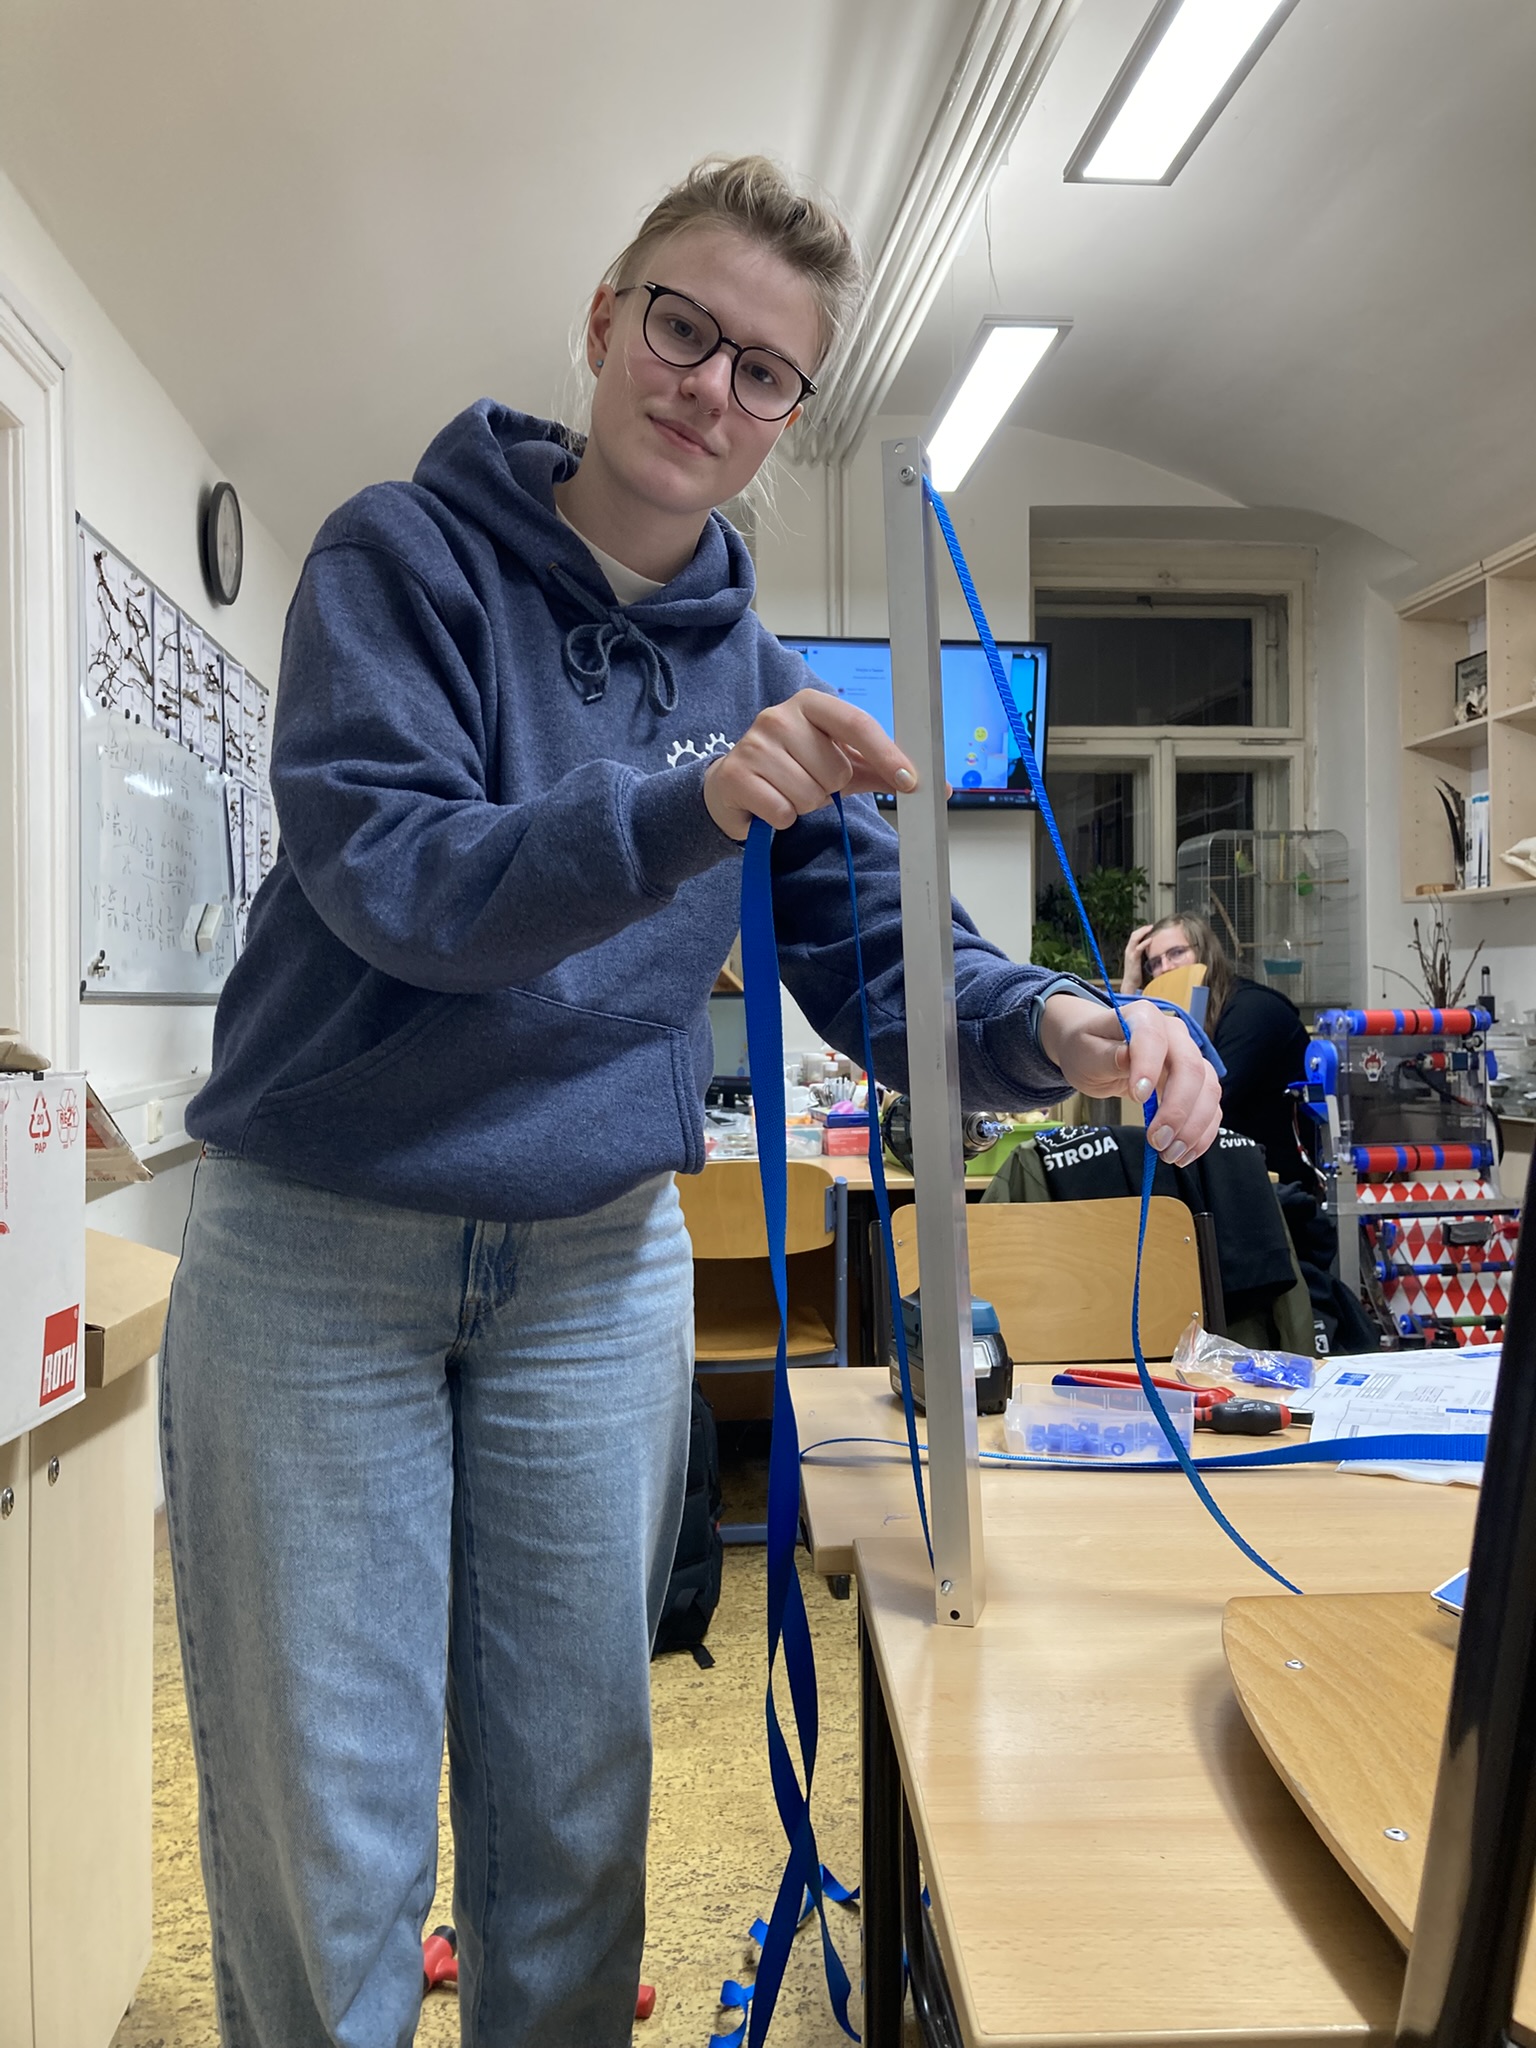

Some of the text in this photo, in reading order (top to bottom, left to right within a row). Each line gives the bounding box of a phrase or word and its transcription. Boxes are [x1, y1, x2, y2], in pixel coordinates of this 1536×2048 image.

[37, 1114, 45, 1125] 20
[34, 1142, 47, 1154] PAP
[1219, 1137, 1248, 1149] ČVUT
[1043, 1135, 1119, 1172] STROJA
[42, 1342, 77, 1397] ROTH
